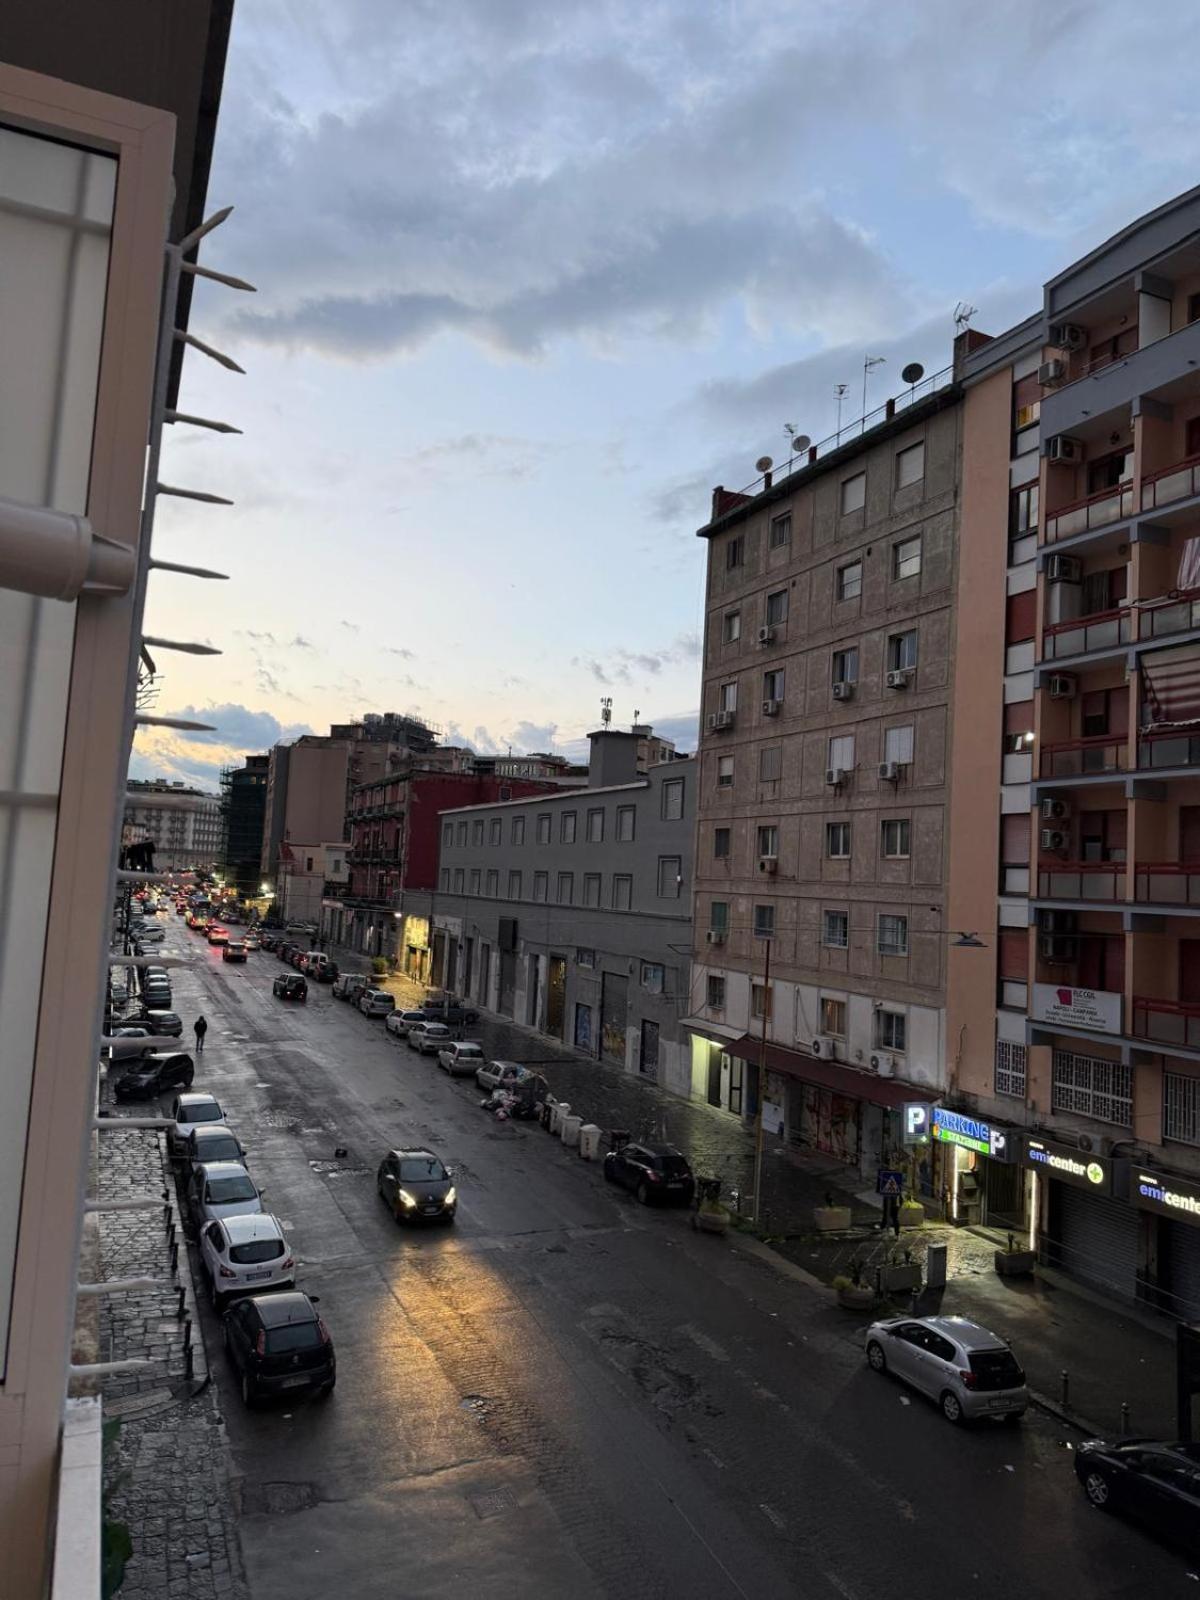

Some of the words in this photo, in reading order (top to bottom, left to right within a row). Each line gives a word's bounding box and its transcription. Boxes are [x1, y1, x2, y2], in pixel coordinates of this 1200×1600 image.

[908, 1107, 925, 1133] P
[933, 1108, 989, 1141] PARKING
[990, 1130, 1005, 1155] P
[1029, 1149, 1086, 1176] emicenter
